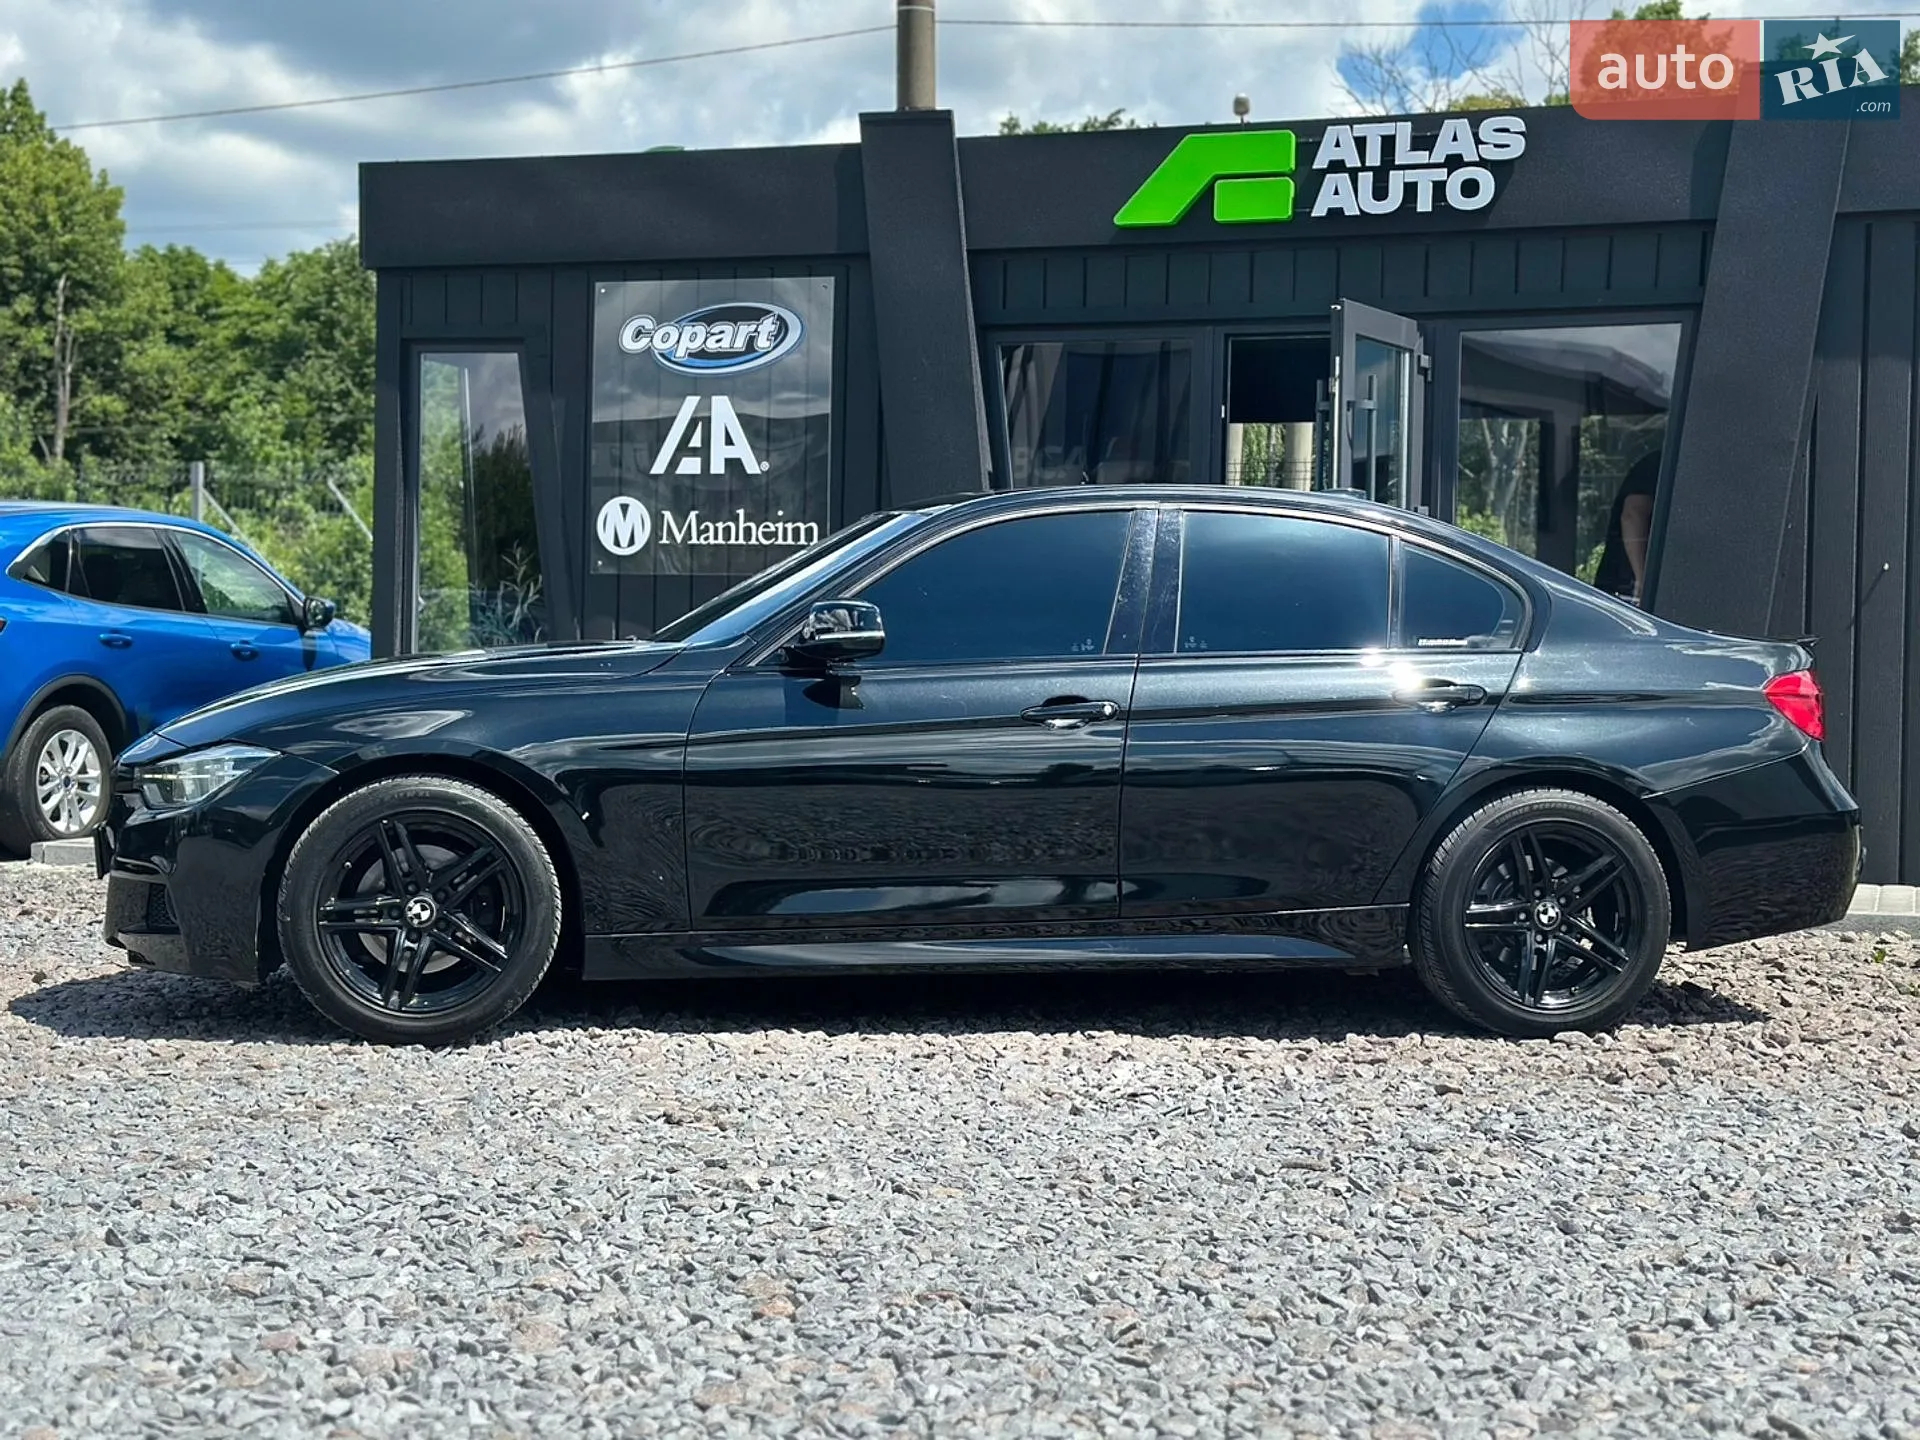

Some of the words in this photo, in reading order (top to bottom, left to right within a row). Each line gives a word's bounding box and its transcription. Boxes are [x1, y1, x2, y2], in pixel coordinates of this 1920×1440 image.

[1311, 115, 1527, 170] ATLAS
[1310, 165, 1496, 218] AUTO
[618, 313, 780, 360] Copart
[658, 508, 819, 547] Manheim
